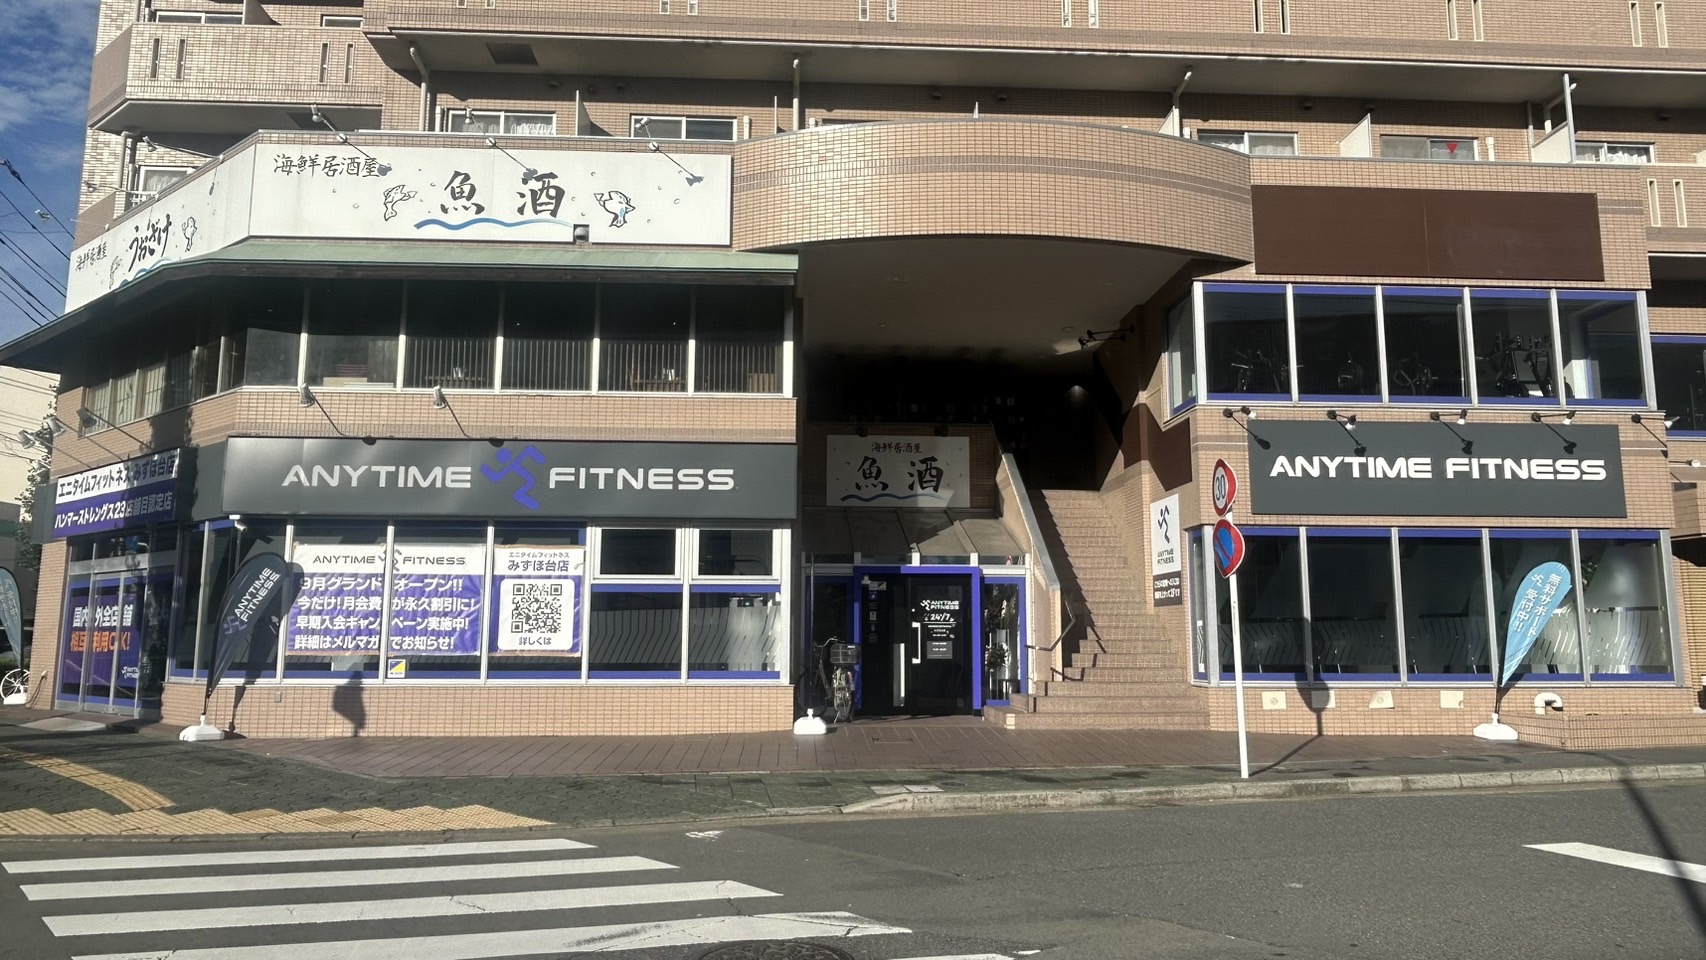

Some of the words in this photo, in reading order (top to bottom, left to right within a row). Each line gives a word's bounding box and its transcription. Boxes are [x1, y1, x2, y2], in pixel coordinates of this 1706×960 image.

[273, 153, 380, 178] 海鮮居酒屋
[872, 442, 922, 454] 海鮮居酒屋
[281, 464, 471, 488] ANYTIME
[549, 467, 735, 491] FITNESS
[1270, 455, 1432, 478] ANYTIME
[1446, 458, 1606, 481] FITNESS
[1215, 474, 1226, 502] 30
[313, 555, 375, 564] ANYTIME
[402, 556, 466, 566] FITNESS
[507, 559, 570, 572] みずほ台店
[508, 551, 570, 559] エニタイムフィットネス
[234, 567, 272, 617] ANYTIME
[240, 572, 280, 622] FITNESS
[518, 636, 553, 646] 詳しくは
